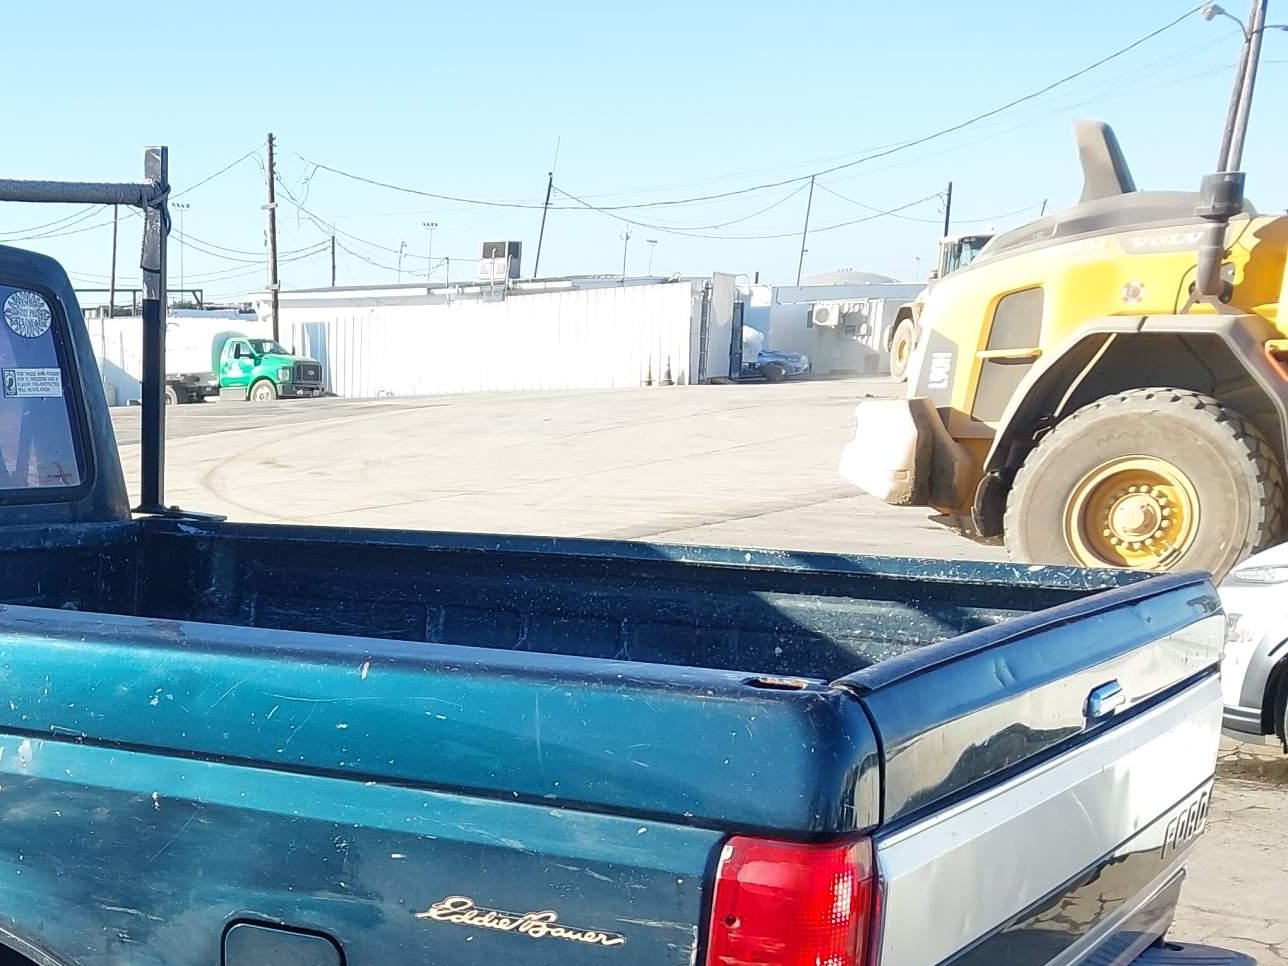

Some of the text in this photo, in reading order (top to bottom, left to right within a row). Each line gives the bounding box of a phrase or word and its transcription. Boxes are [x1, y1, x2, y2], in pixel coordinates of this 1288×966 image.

[1161, 791, 1209, 860] FORD
[414, 896, 626, 946] Eddie Bauer
